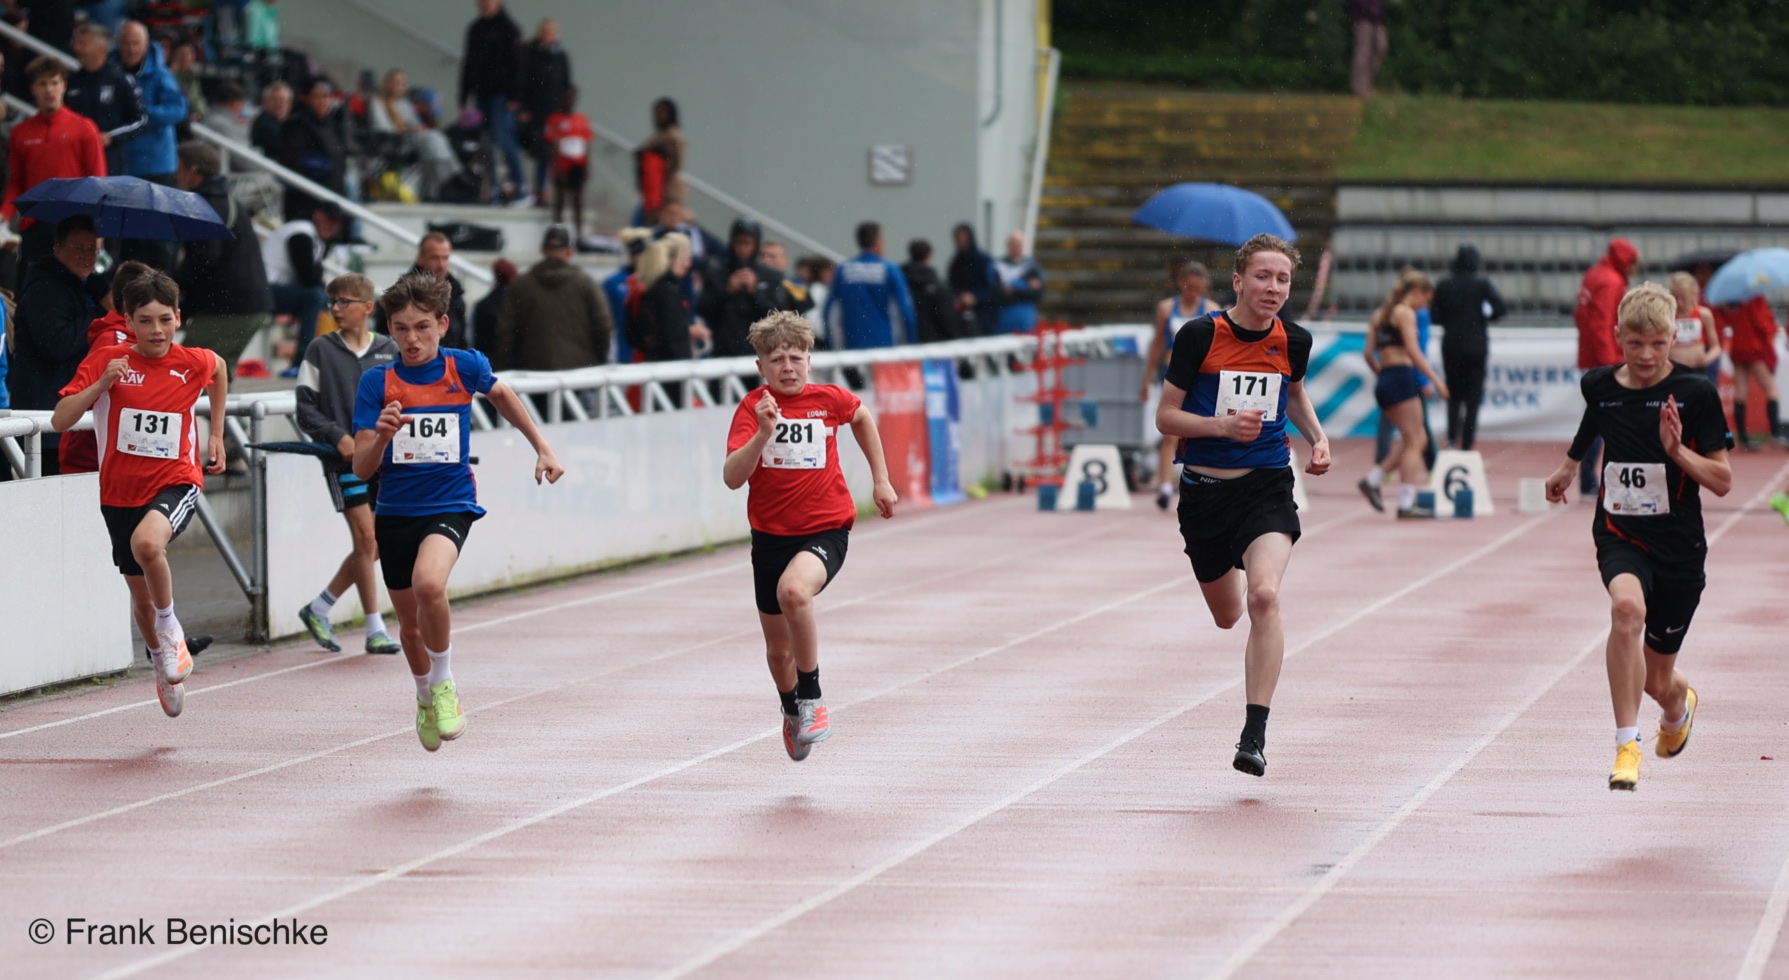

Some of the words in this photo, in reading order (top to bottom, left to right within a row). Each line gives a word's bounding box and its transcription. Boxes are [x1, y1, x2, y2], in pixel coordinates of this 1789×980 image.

[1232, 375, 1268, 396] 171
[133, 413, 169, 435] 131
[407, 417, 448, 438] 164
[775, 423, 813, 444] 281
[1082, 459, 1107, 495] 8
[1444, 466, 1469, 502] 6
[1619, 467, 1646, 489] 46
